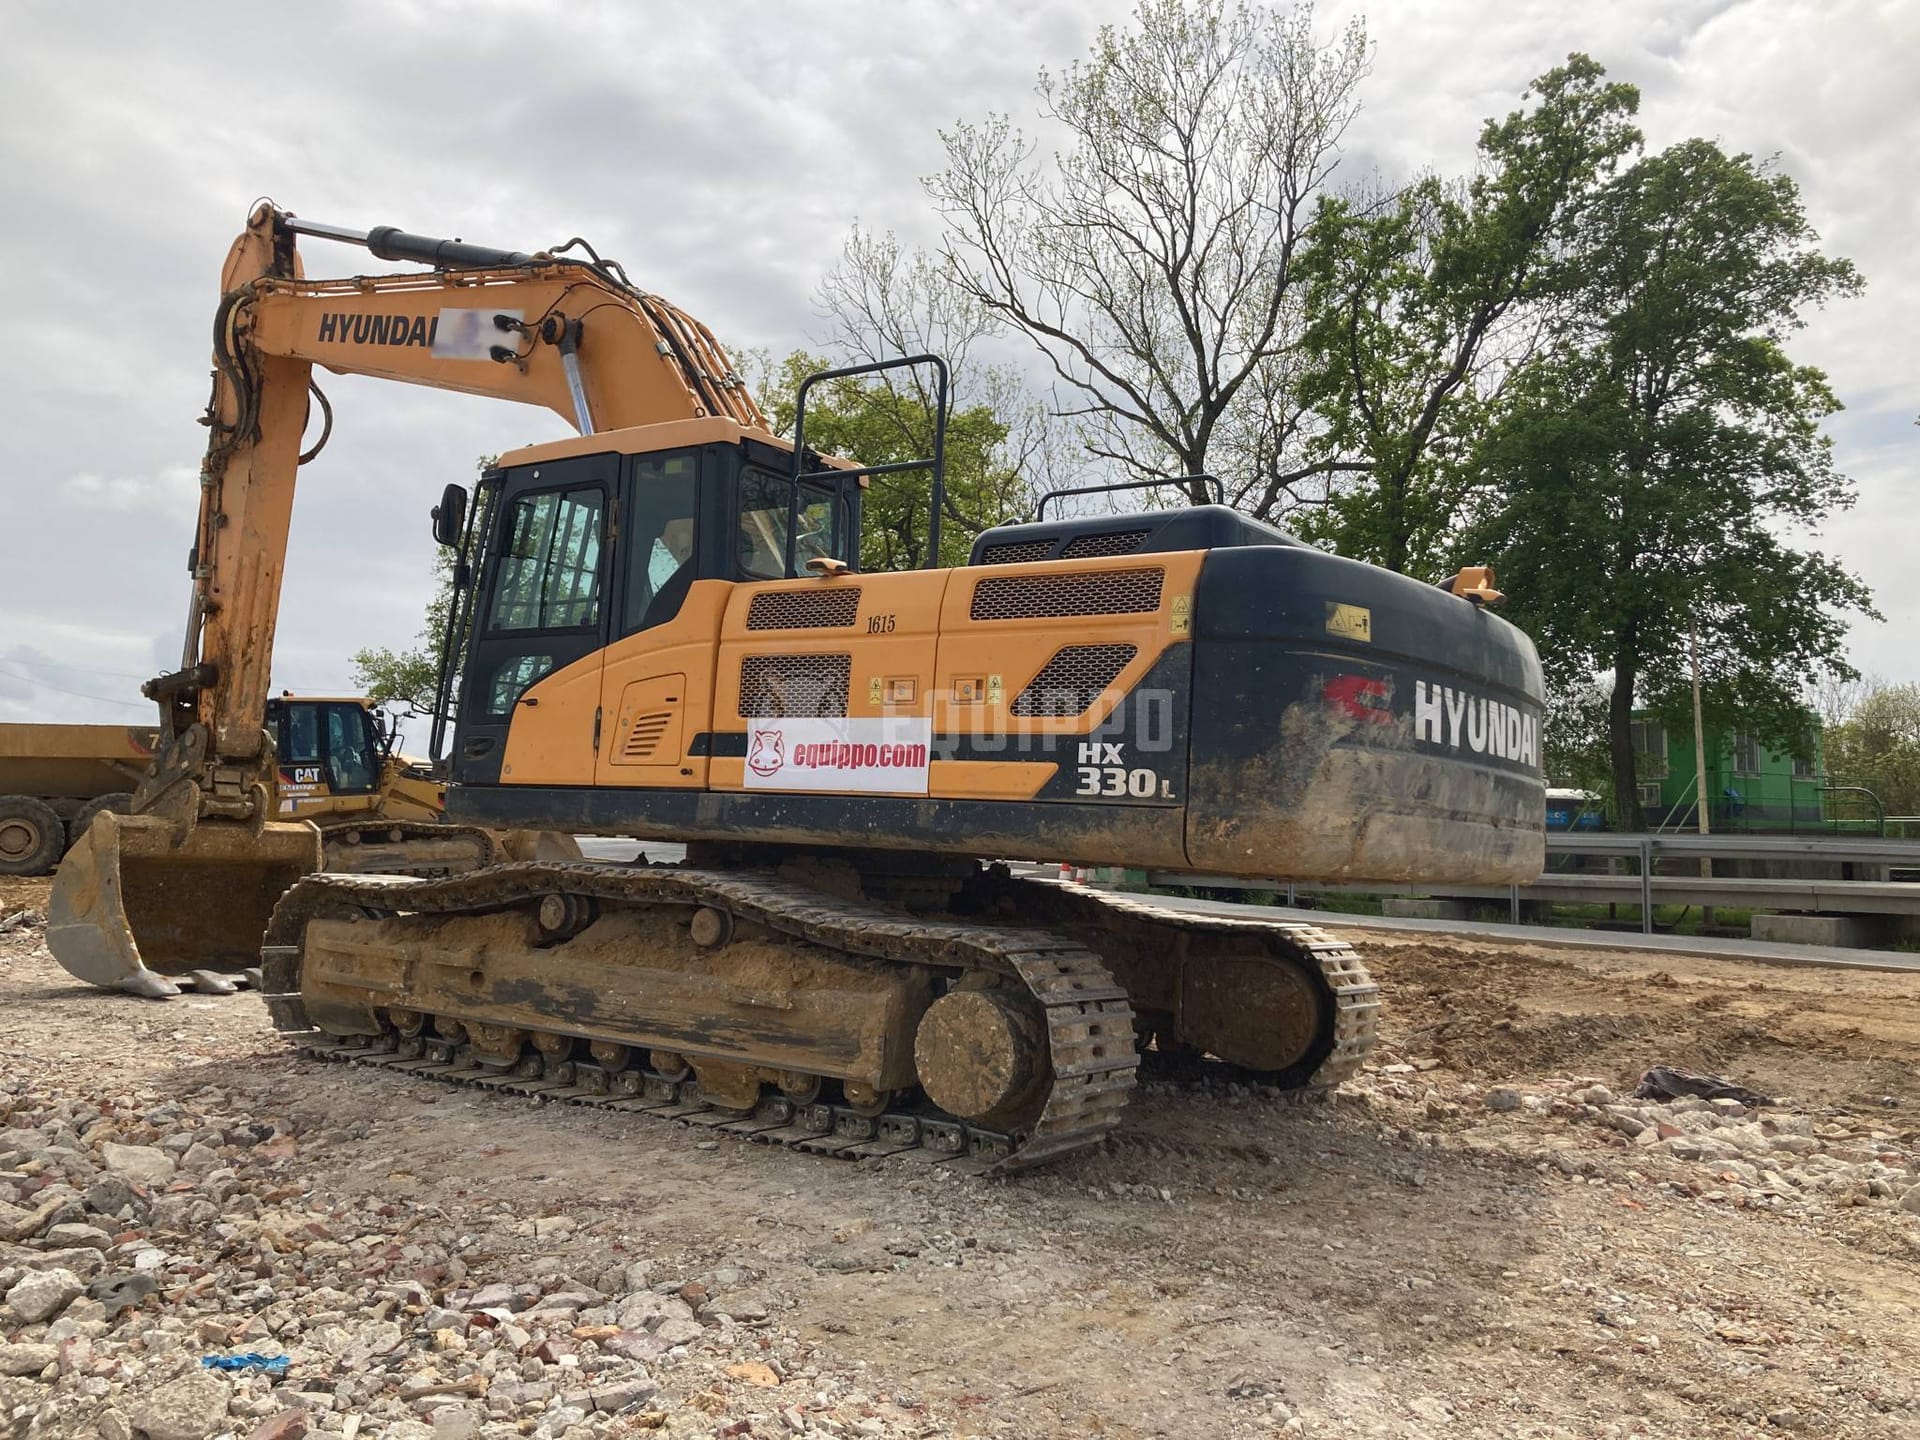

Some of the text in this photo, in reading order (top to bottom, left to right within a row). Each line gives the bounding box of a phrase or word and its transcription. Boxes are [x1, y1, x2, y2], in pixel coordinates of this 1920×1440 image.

[318, 313, 439, 348] HYUNDAI
[867, 614, 896, 634] 1615
[1415, 680, 1537, 768] HYUNDAI
[793, 740, 926, 770] equippo.com
[1078, 742, 1125, 765] HX
[295, 768, 320, 783] CAT
